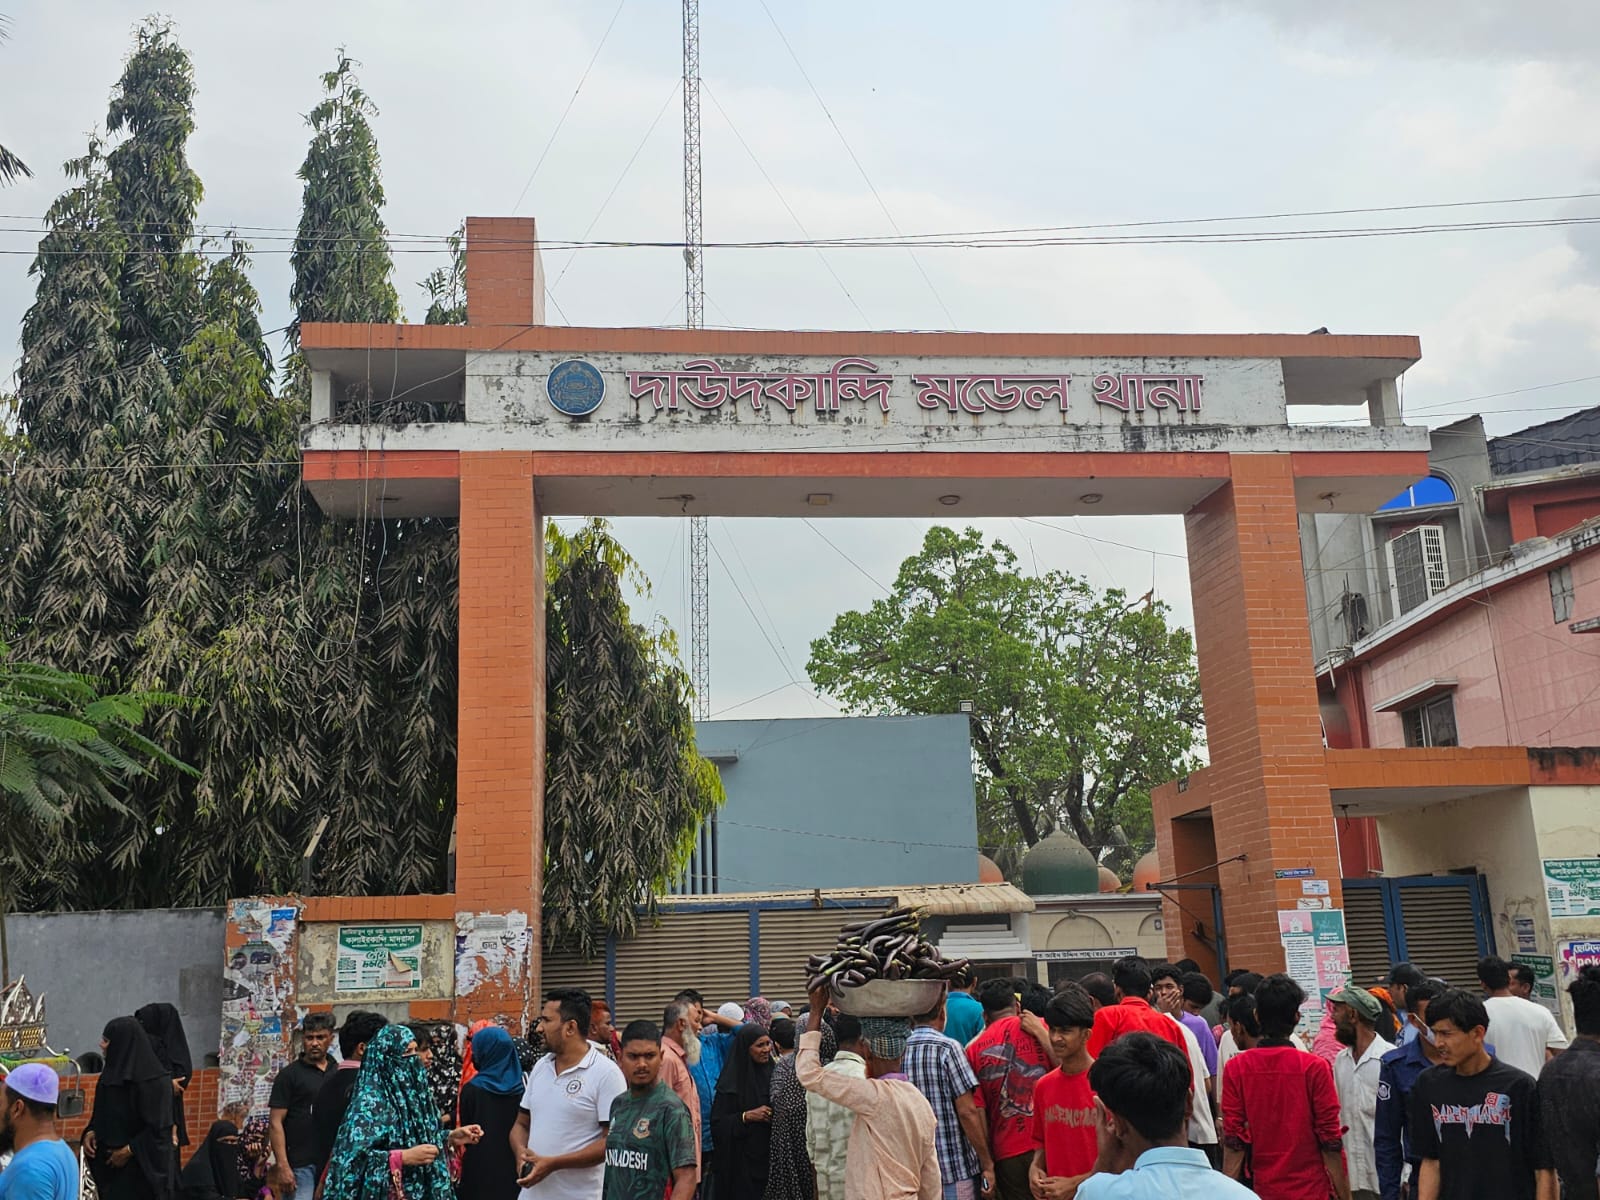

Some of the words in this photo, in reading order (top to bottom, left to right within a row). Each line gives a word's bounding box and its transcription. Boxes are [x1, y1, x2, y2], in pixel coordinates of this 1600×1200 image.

[625, 358, 894, 412] দাউদকান্দি
[911, 373, 1072, 412] মডেল
[1093, 373, 1204, 412] থানা
[605, 1149, 649, 1171] ANLADESH
